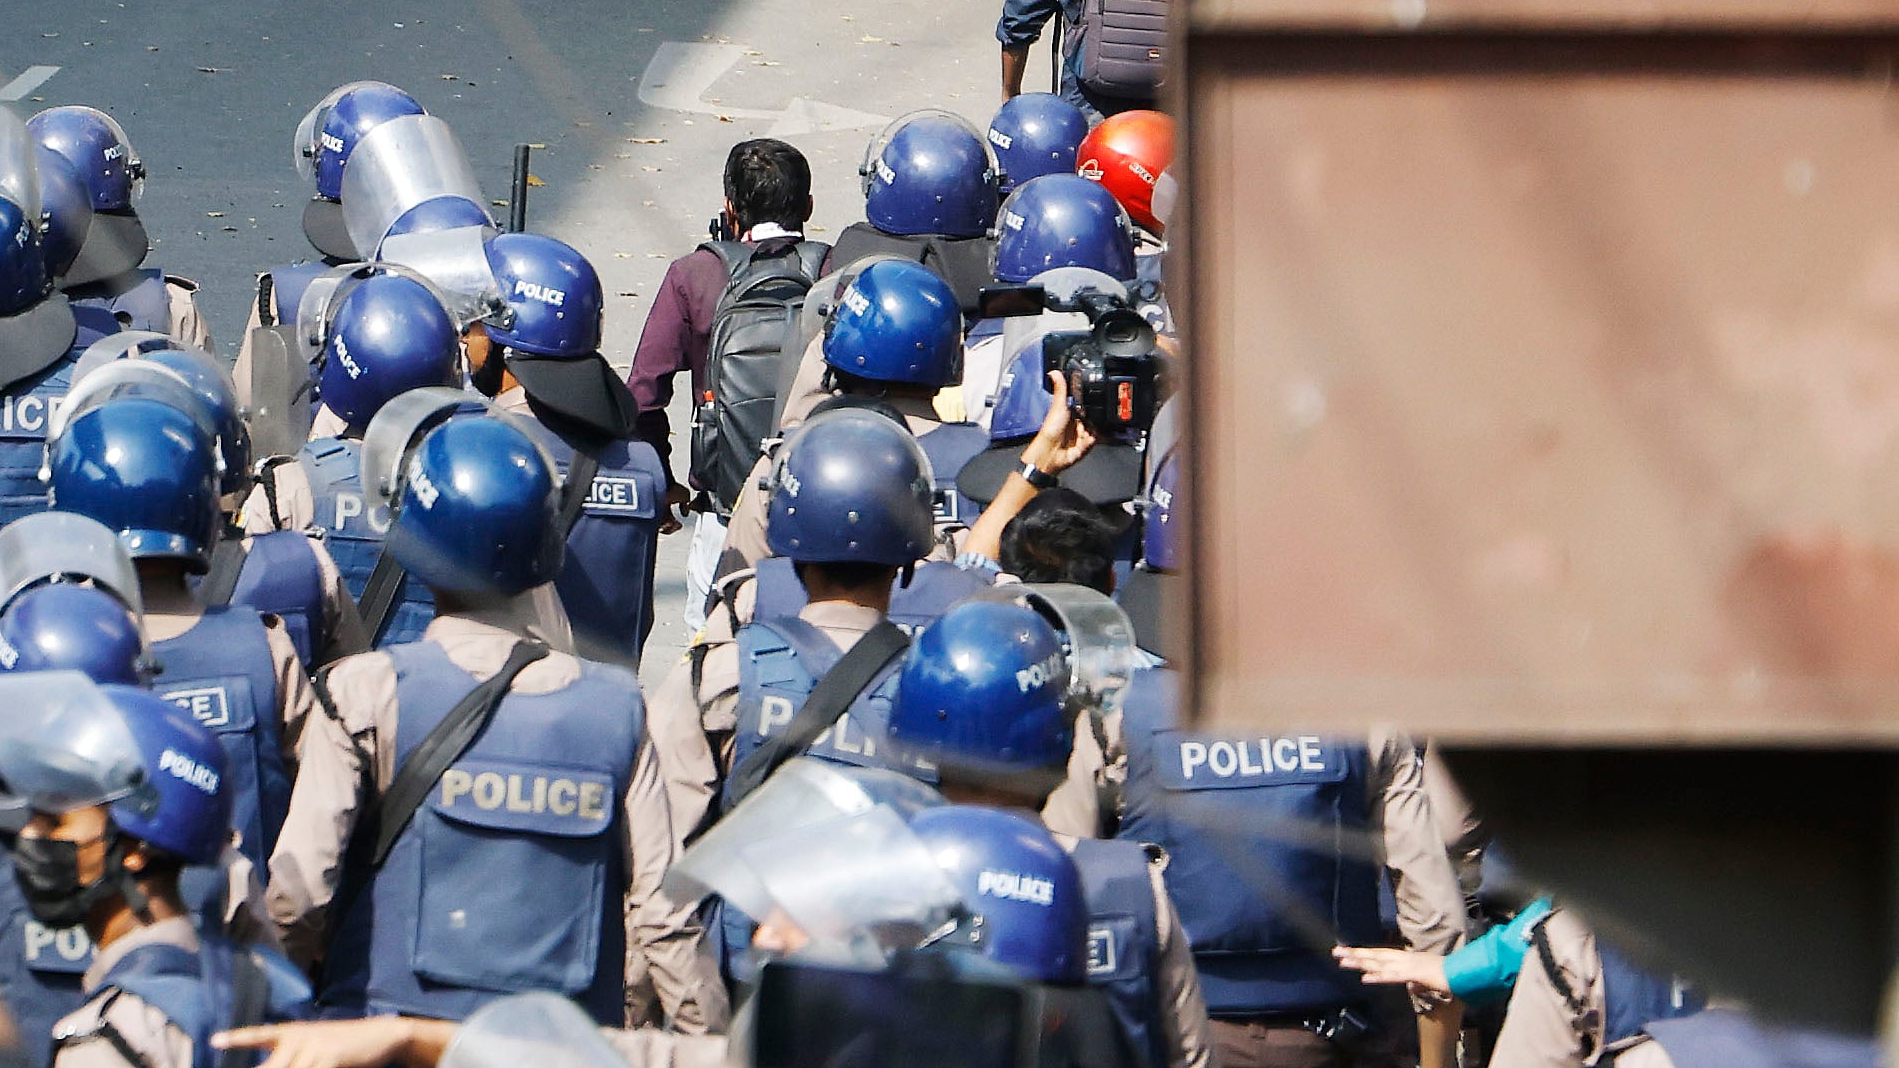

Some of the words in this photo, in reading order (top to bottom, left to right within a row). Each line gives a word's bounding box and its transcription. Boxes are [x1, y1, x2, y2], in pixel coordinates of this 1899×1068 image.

[515, 280, 566, 307] POLICE
[585, 482, 627, 504] ICE
[1180, 735, 1326, 779] POLICE
[440, 769, 606, 820] POLICE
[978, 870, 1055, 906] POLICE
